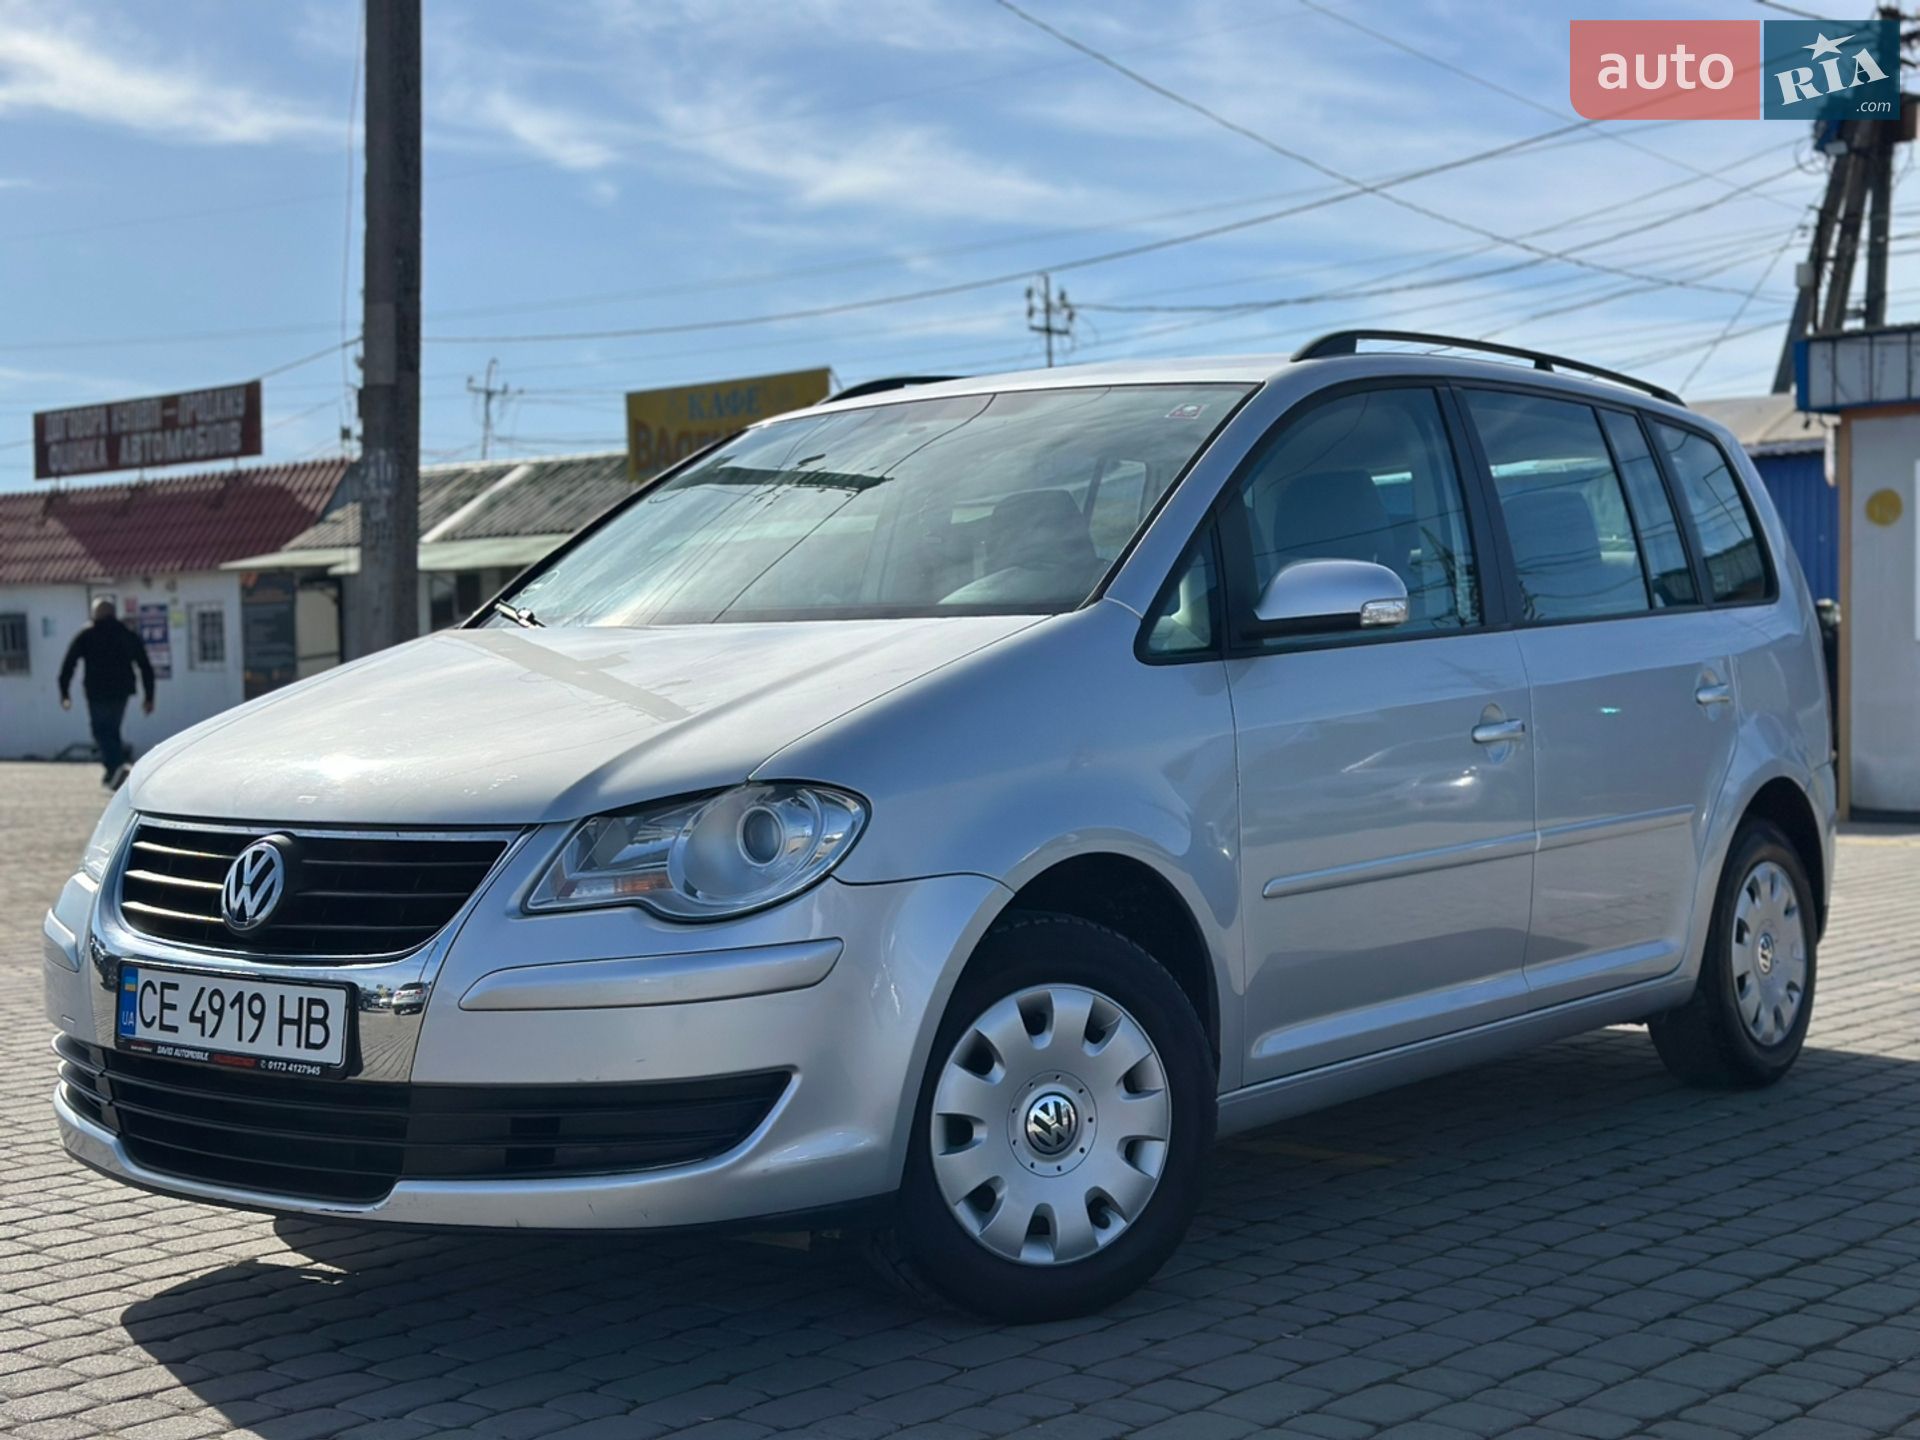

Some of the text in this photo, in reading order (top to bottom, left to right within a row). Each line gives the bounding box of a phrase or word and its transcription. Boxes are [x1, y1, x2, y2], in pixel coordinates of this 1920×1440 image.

[121, 1010, 135, 1027] UA
[138, 979, 331, 1051] CE 4919 HB
[268, 1061, 322, 1076] 0173 4127945
